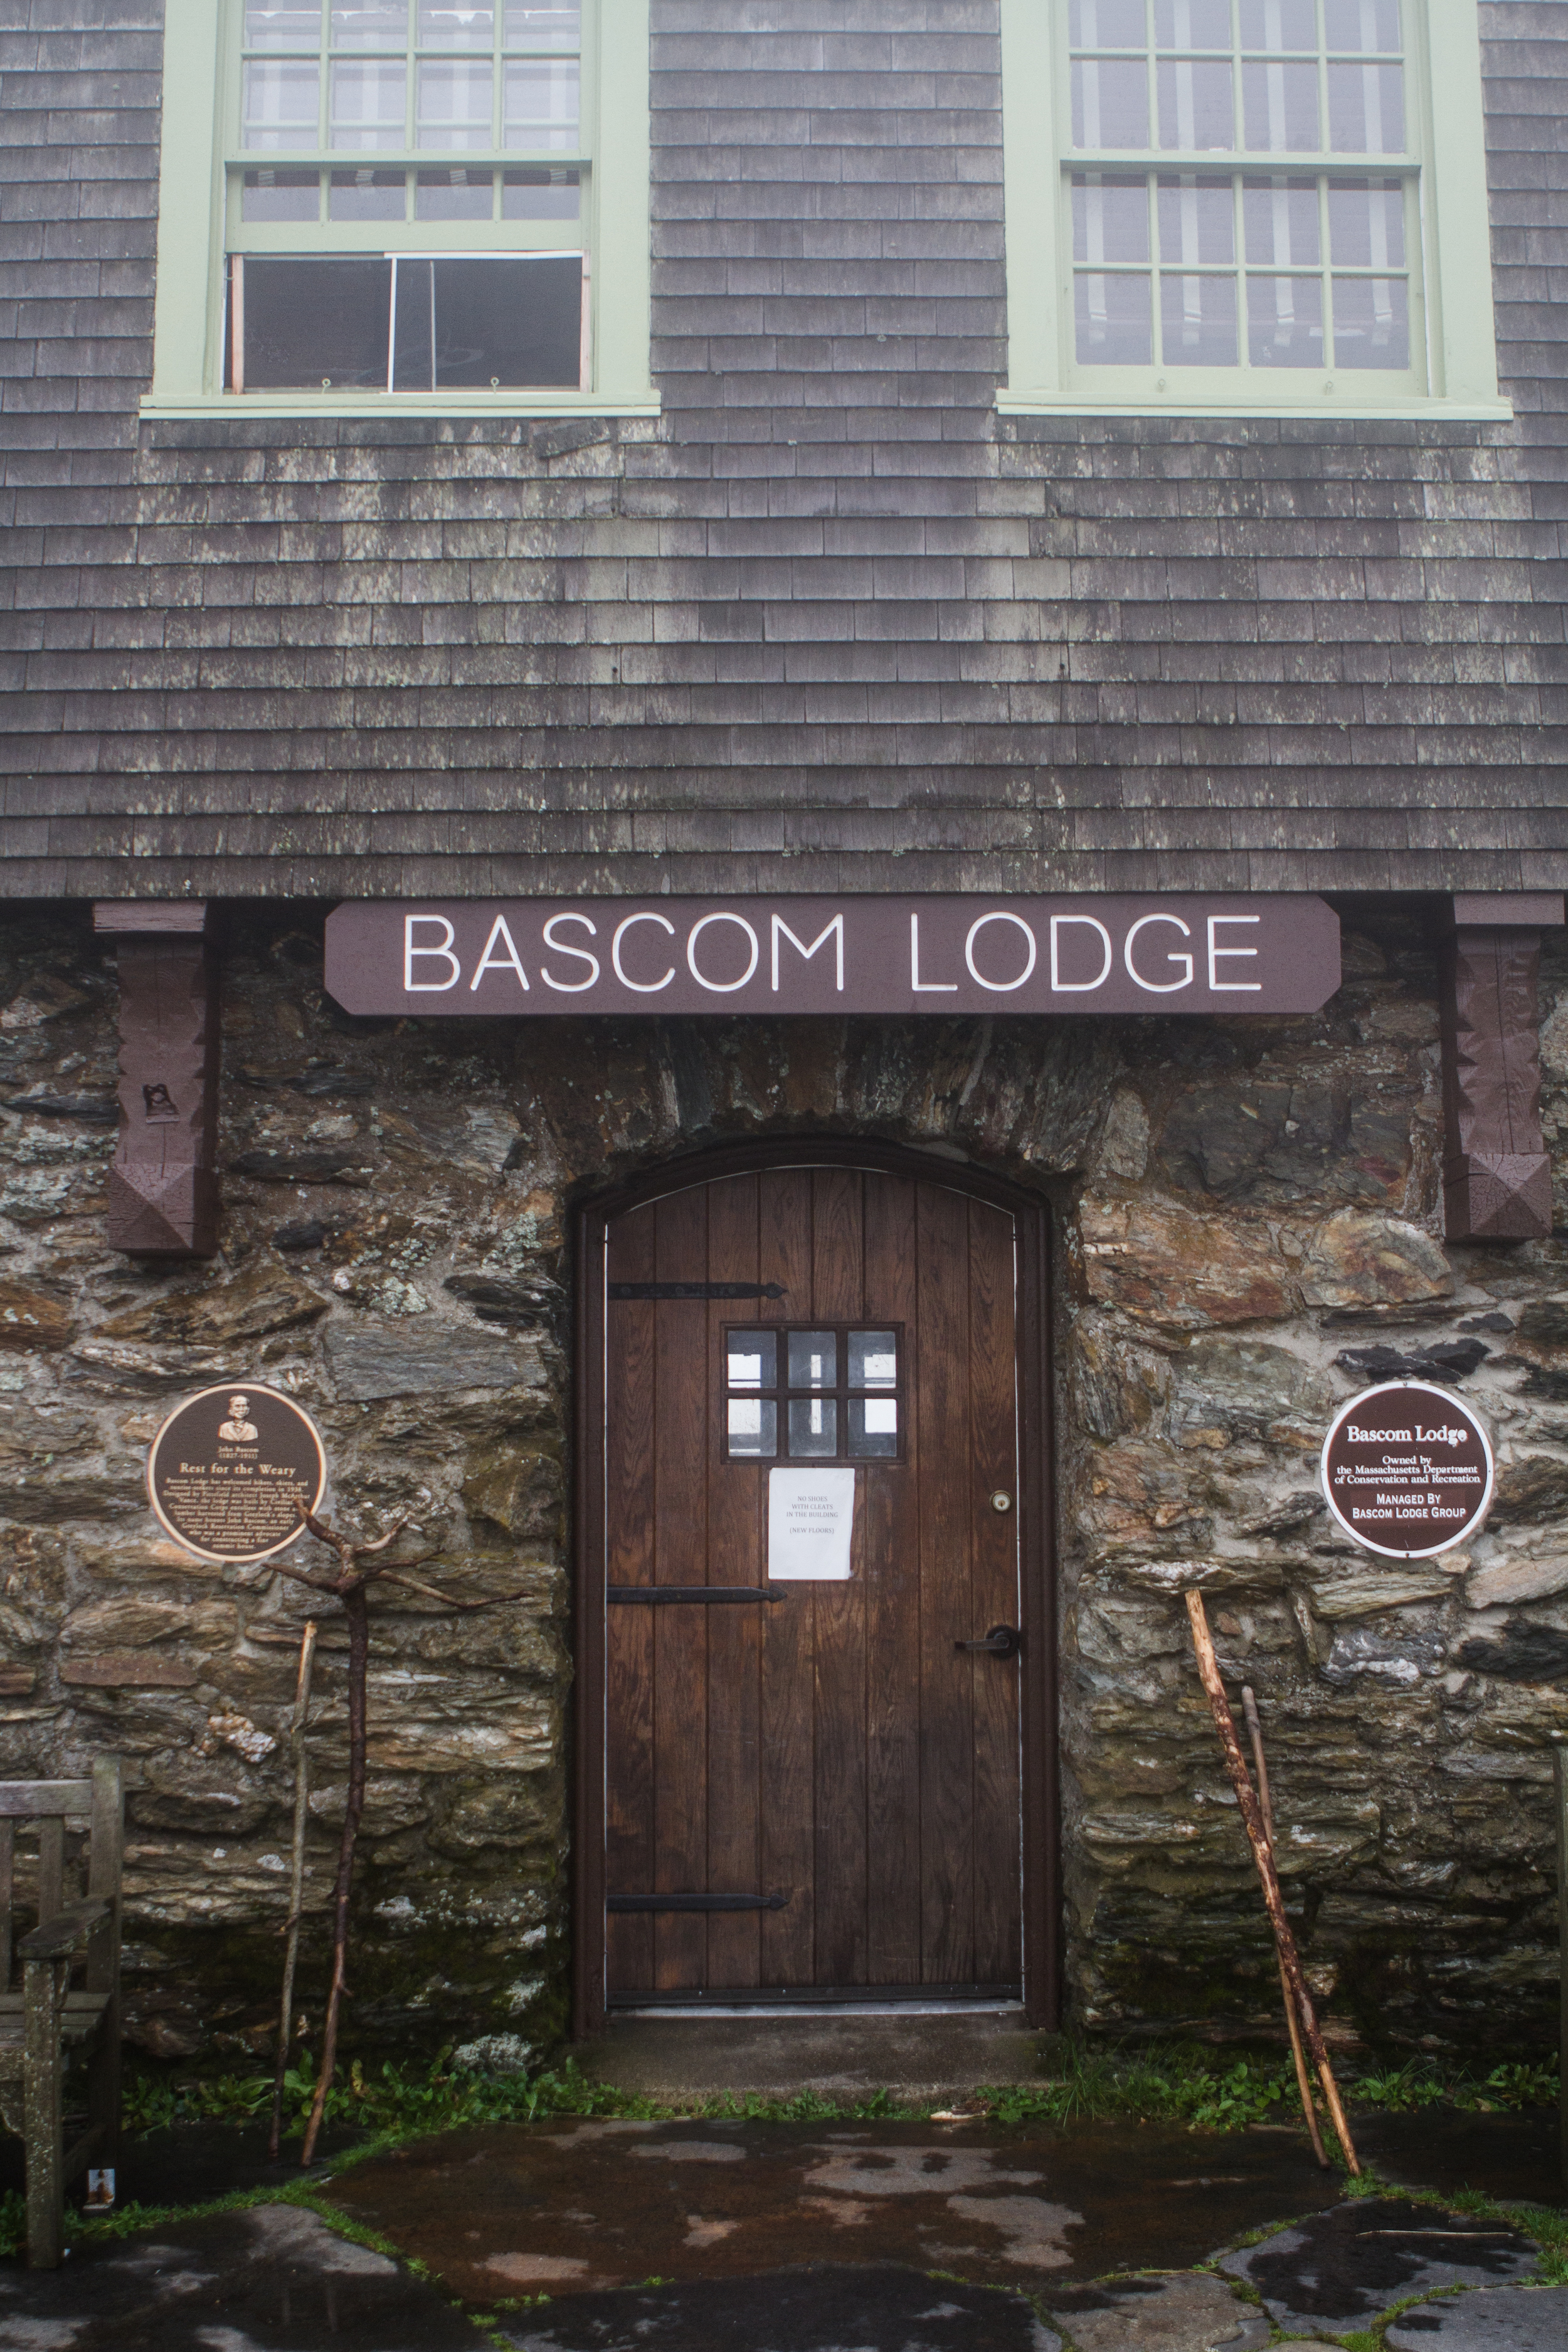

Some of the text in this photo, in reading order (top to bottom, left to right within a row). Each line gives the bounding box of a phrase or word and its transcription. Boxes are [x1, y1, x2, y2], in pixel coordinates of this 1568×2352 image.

[405, 912, 1261, 992] BASCOM LODGE
[1347, 1425, 1468, 1447] Bascom Lodge
[1382, 1455, 1432, 1466] Owned by
[179, 1462, 296, 1478] Rest for the Weary
[1337, 1465, 1477, 1476] the Massachusetts Department
[190, 1478, 209, 1487] Lodge
[1334, 1475, 1480, 1484] of Conservation and Recreation
[162, 1490, 191, 1498] Designed
